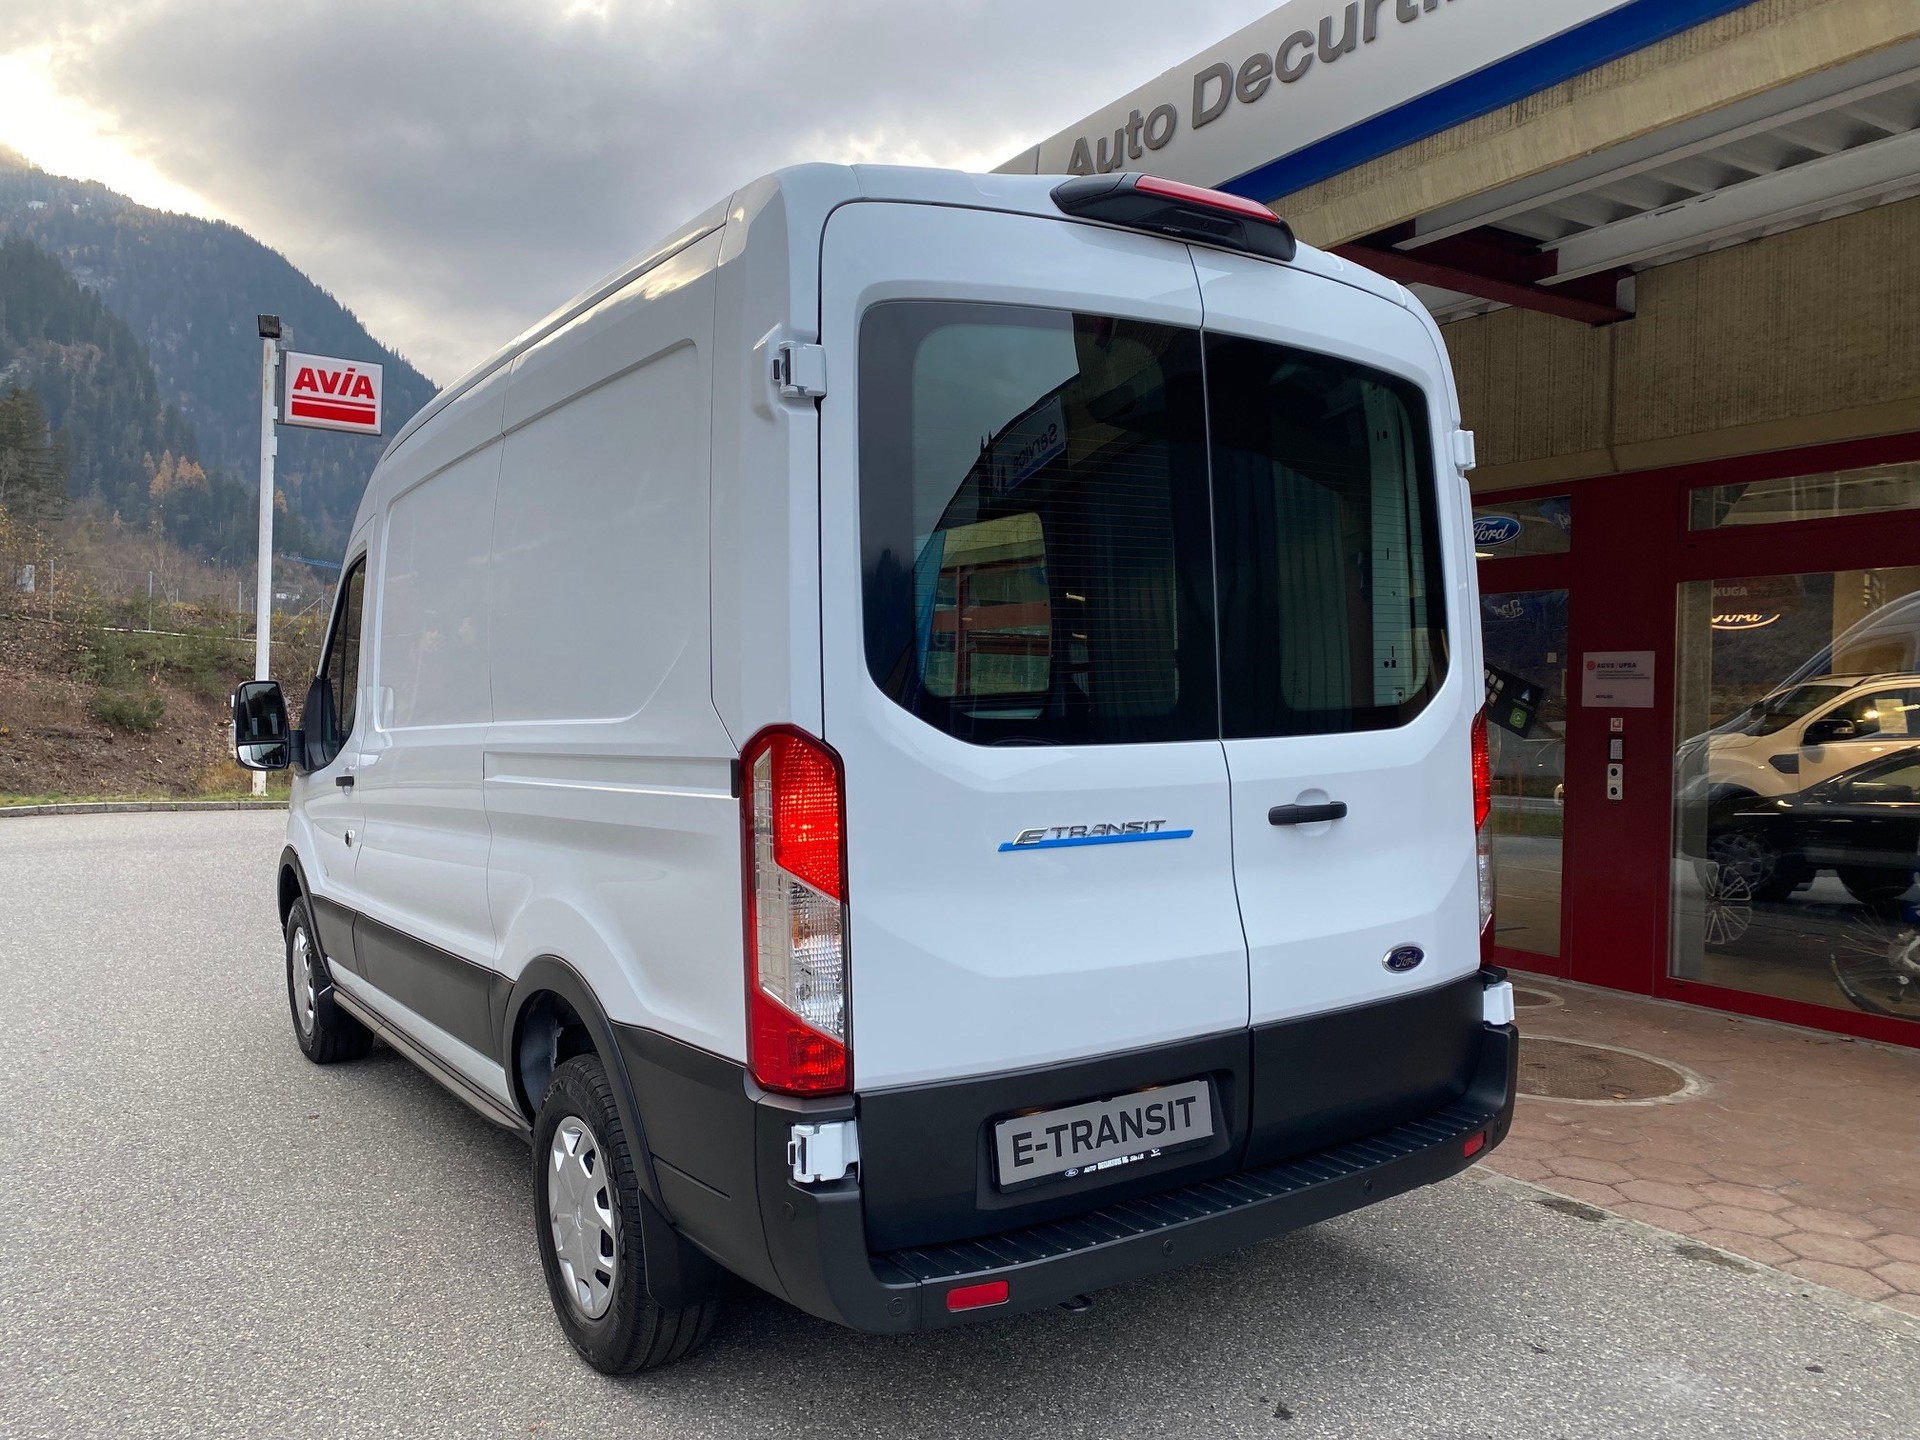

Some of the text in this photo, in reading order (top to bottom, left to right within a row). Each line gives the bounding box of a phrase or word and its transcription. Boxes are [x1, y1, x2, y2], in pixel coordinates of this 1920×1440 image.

[1066, 103, 1177, 175] Auto
[1473, 519, 1508, 542] Ford
[1713, 586, 1748, 598] KUGA
[1012, 1096, 1197, 1168] E-TRANSIT
